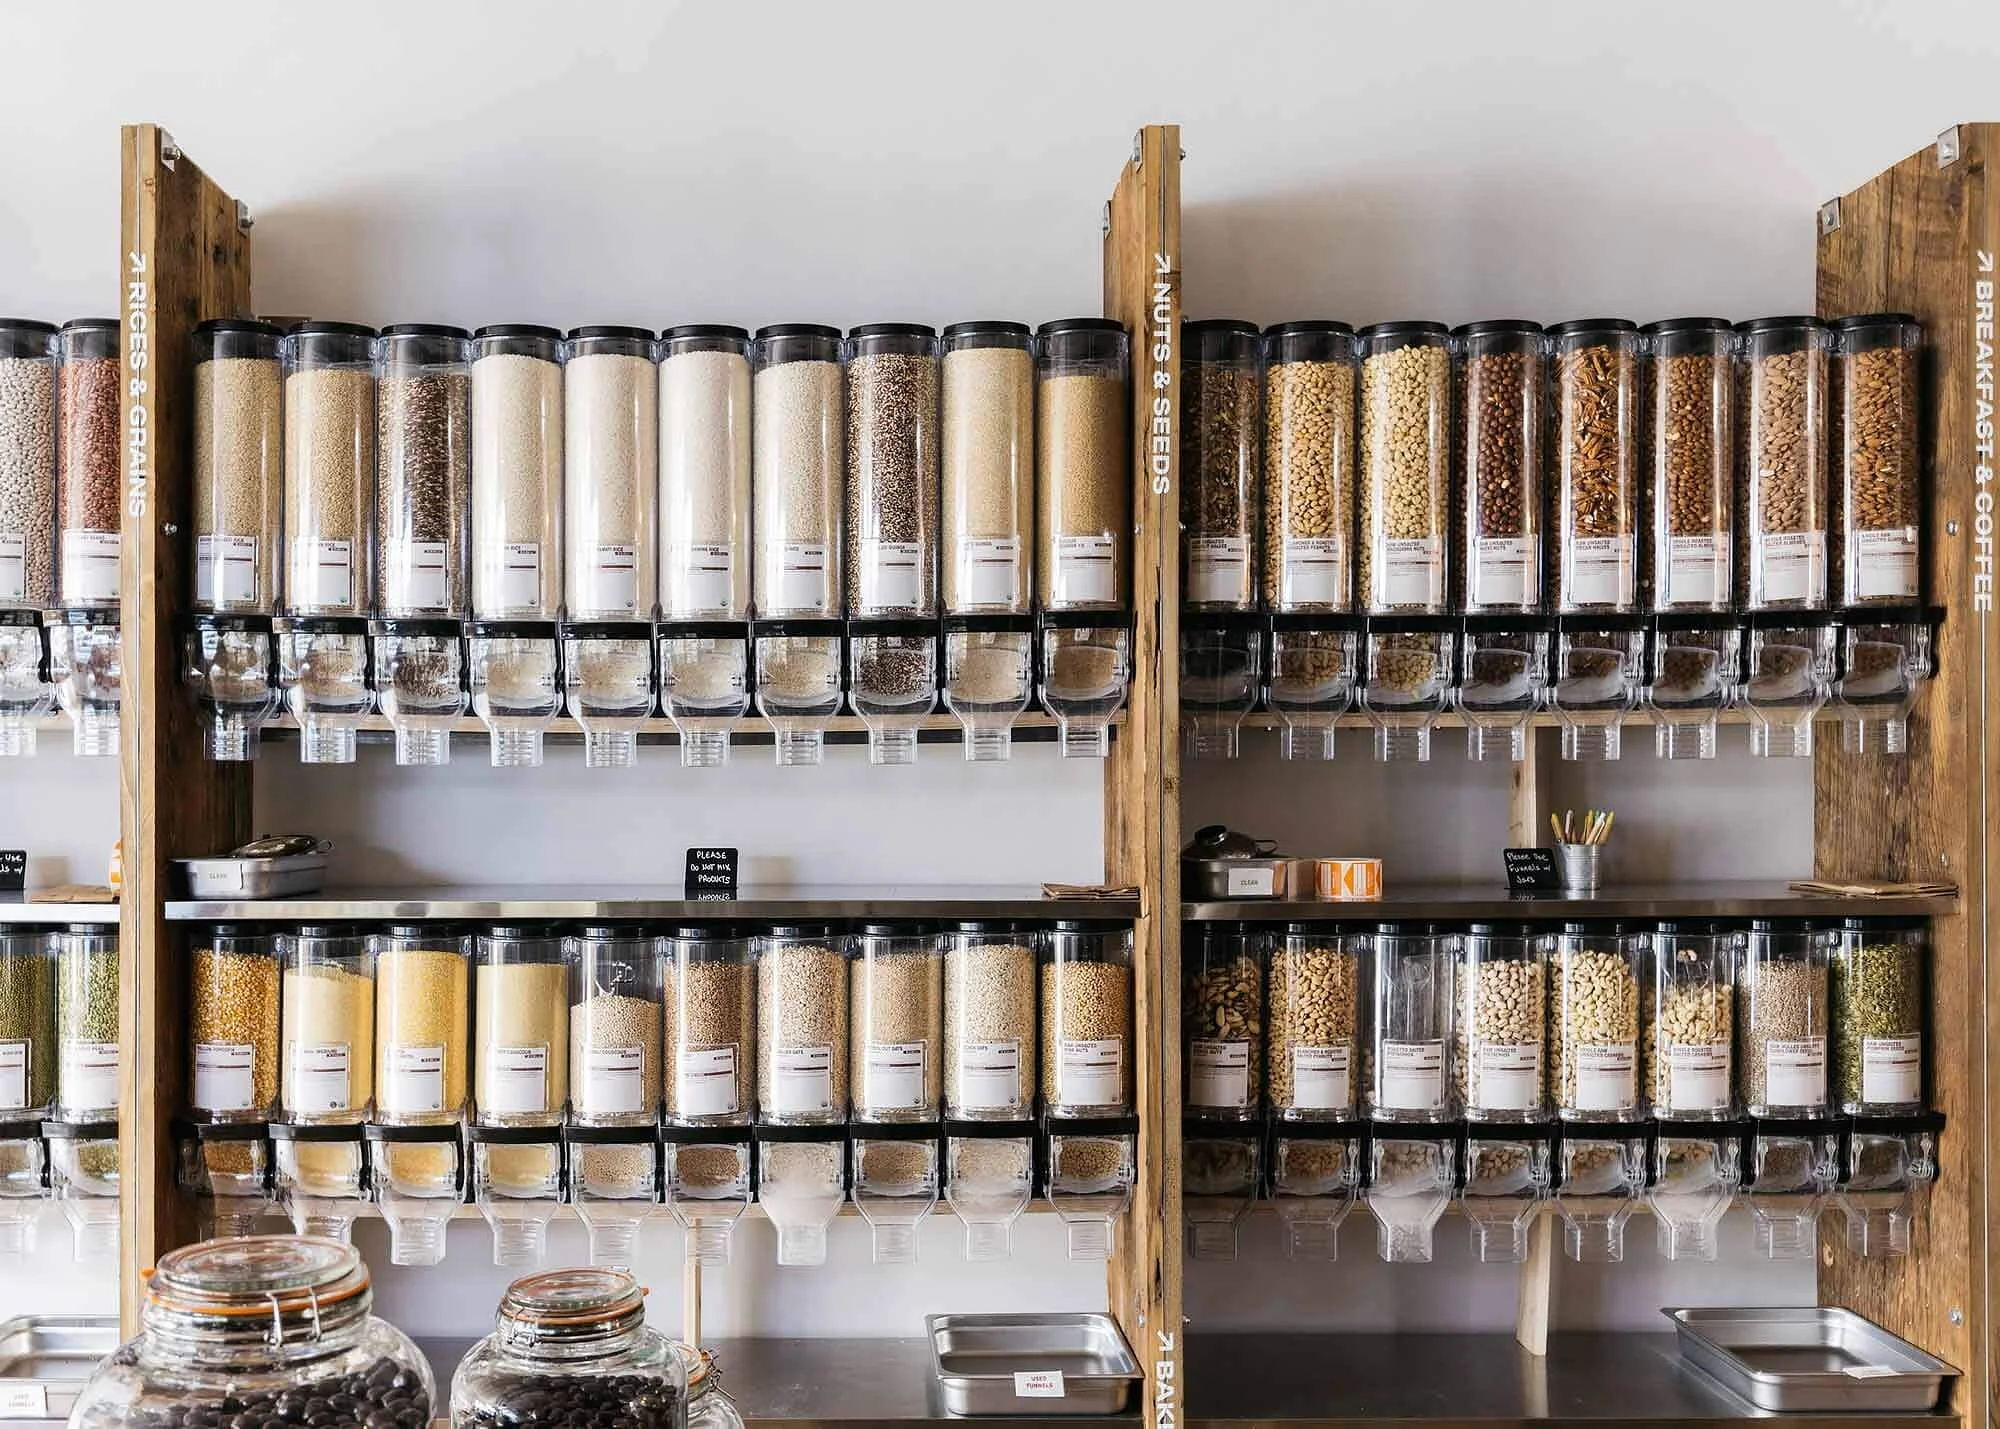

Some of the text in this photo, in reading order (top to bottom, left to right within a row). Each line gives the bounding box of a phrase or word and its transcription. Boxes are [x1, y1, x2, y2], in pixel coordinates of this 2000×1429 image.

[129, 281, 147, 518] RICES & GRAINS
[1153, 283, 1171, 495] NUTS & SEEDS
[1974, 281, 1994, 612] BREAKFAST & COFFEE
[696, 851, 727, 860] PLEASE
[717, 863, 731, 872] MIX
